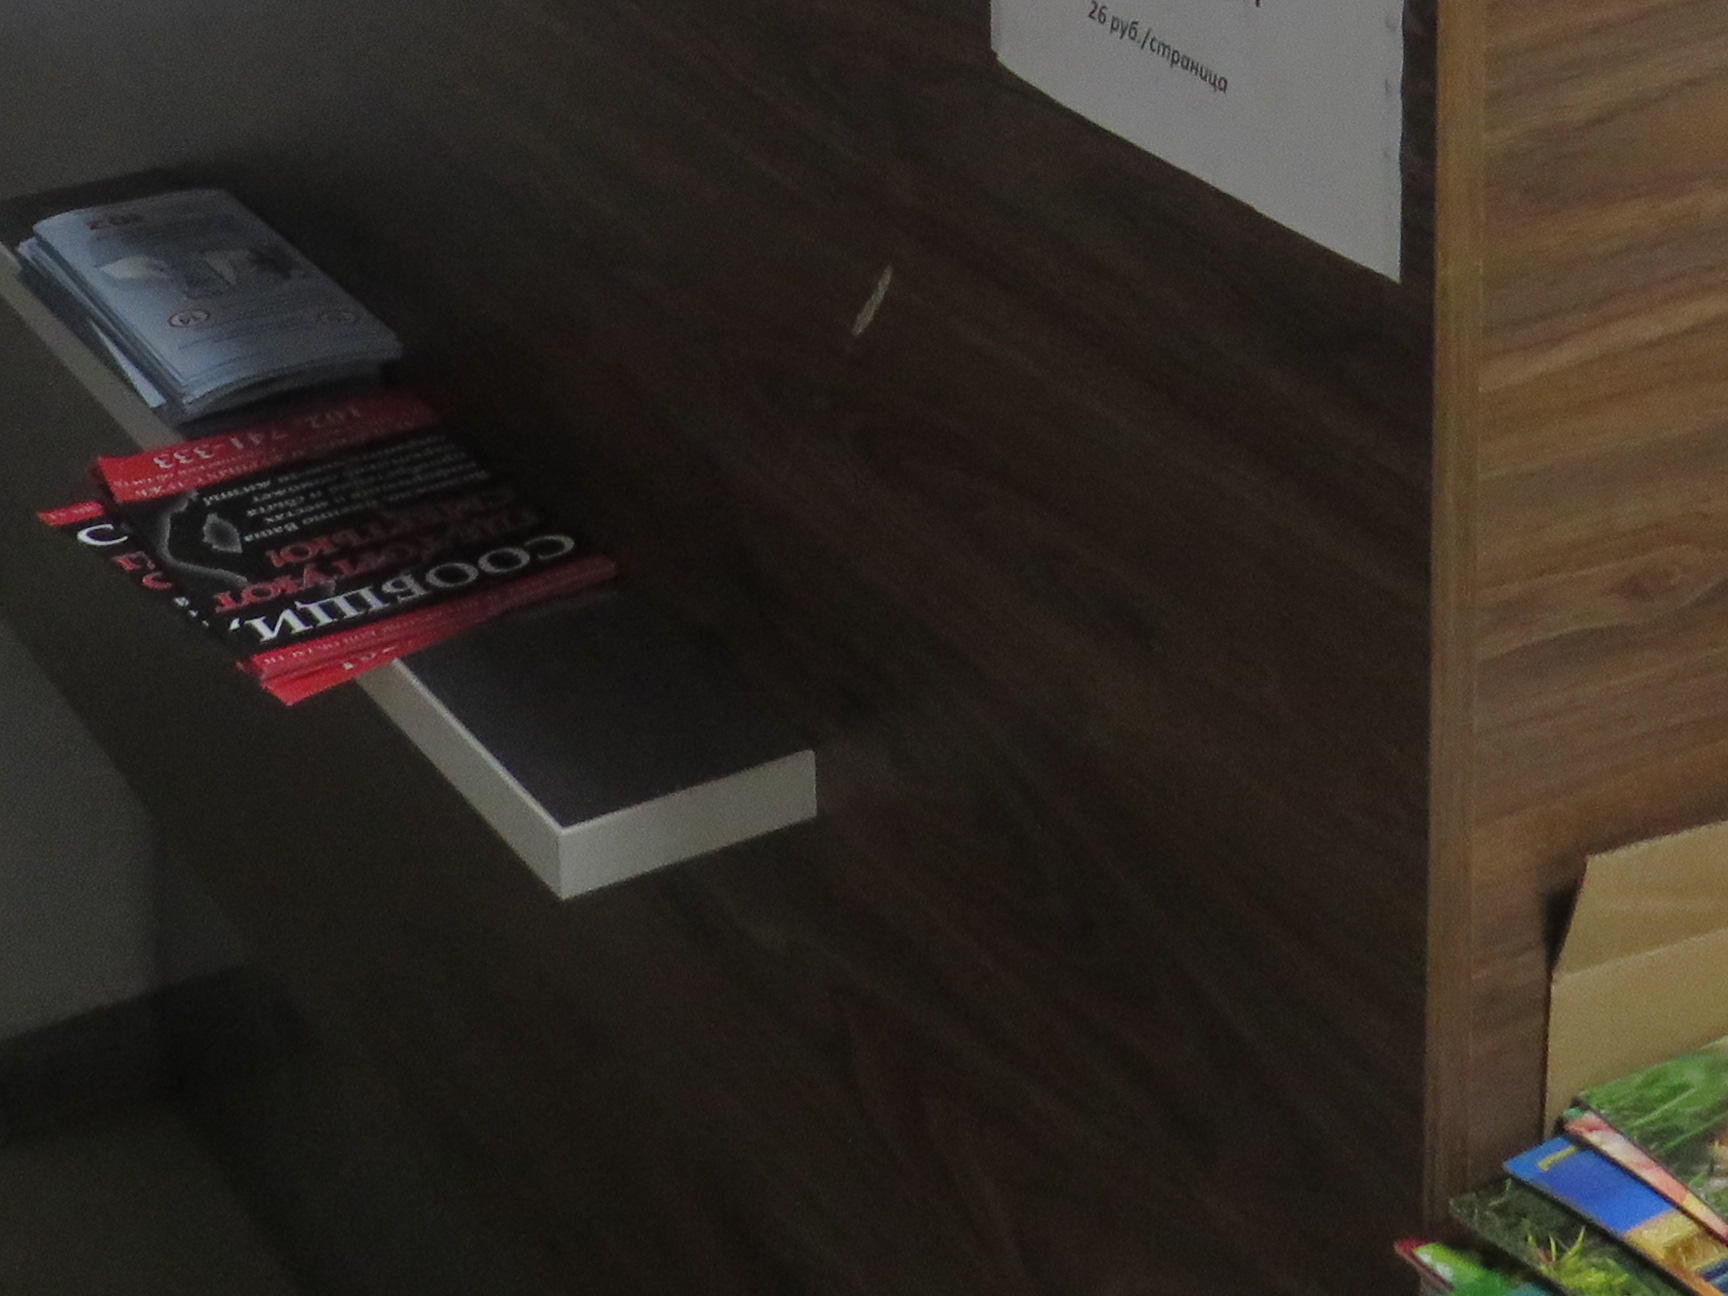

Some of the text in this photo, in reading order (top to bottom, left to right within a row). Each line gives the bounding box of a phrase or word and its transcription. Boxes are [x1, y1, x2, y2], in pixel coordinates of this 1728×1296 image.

[1088, 0, 1230, 97] 26 руб./страница
[229, 534, 575, 644] СООБЩИ,
